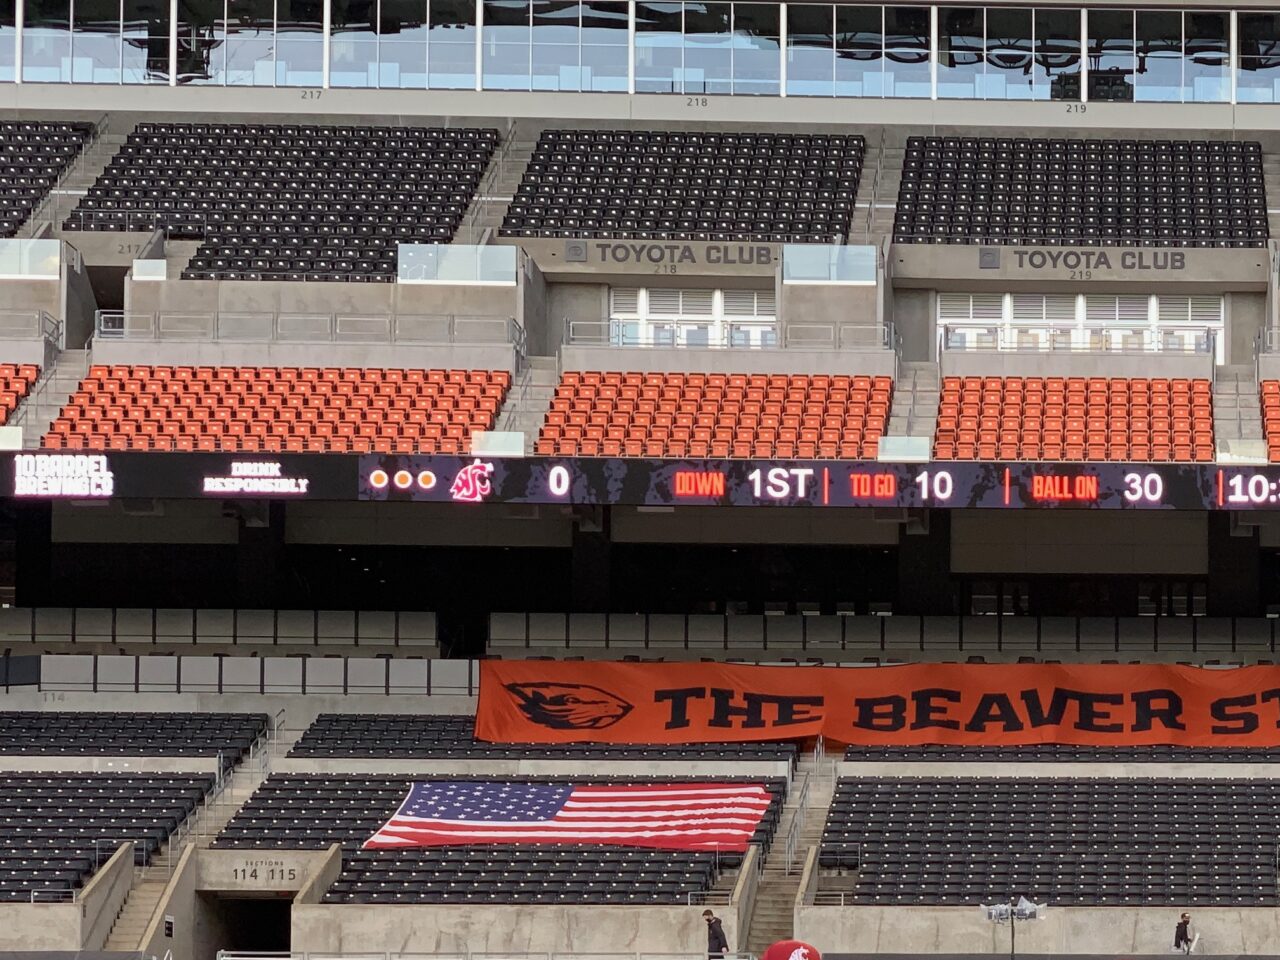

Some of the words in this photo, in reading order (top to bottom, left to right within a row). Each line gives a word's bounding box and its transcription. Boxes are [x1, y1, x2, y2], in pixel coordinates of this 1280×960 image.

[301, 90, 322, 100] 217
[687, 97, 709, 107] 218
[1066, 103, 1087, 113] 219
[118, 244, 141, 254] 217
[596, 243, 696, 264] TOYOTA
[705, 245, 772, 265] CLUB
[1013, 250, 1112, 269] TOYOTA
[1121, 251, 1186, 270] CLUB
[653, 264, 677, 274] 218
[1069, 270, 1092, 280] 219
[548, 465, 570, 496] 0
[675, 471, 725, 497] DOWN
[747, 467, 814, 499] 1ST
[850, 473, 871, 497] TO
[873, 473, 895, 497] GO
[915, 471, 953, 500] 10
[1032, 474, 1073, 499] BALL
[1074, 475, 1098, 500] ON
[1123, 472, 1164, 500] 30
[654, 687, 824, 730] THE
[855, 686, 1186, 732] BEAVER
[233, 868, 258, 881] 114
[269, 868, 296, 881] 115
